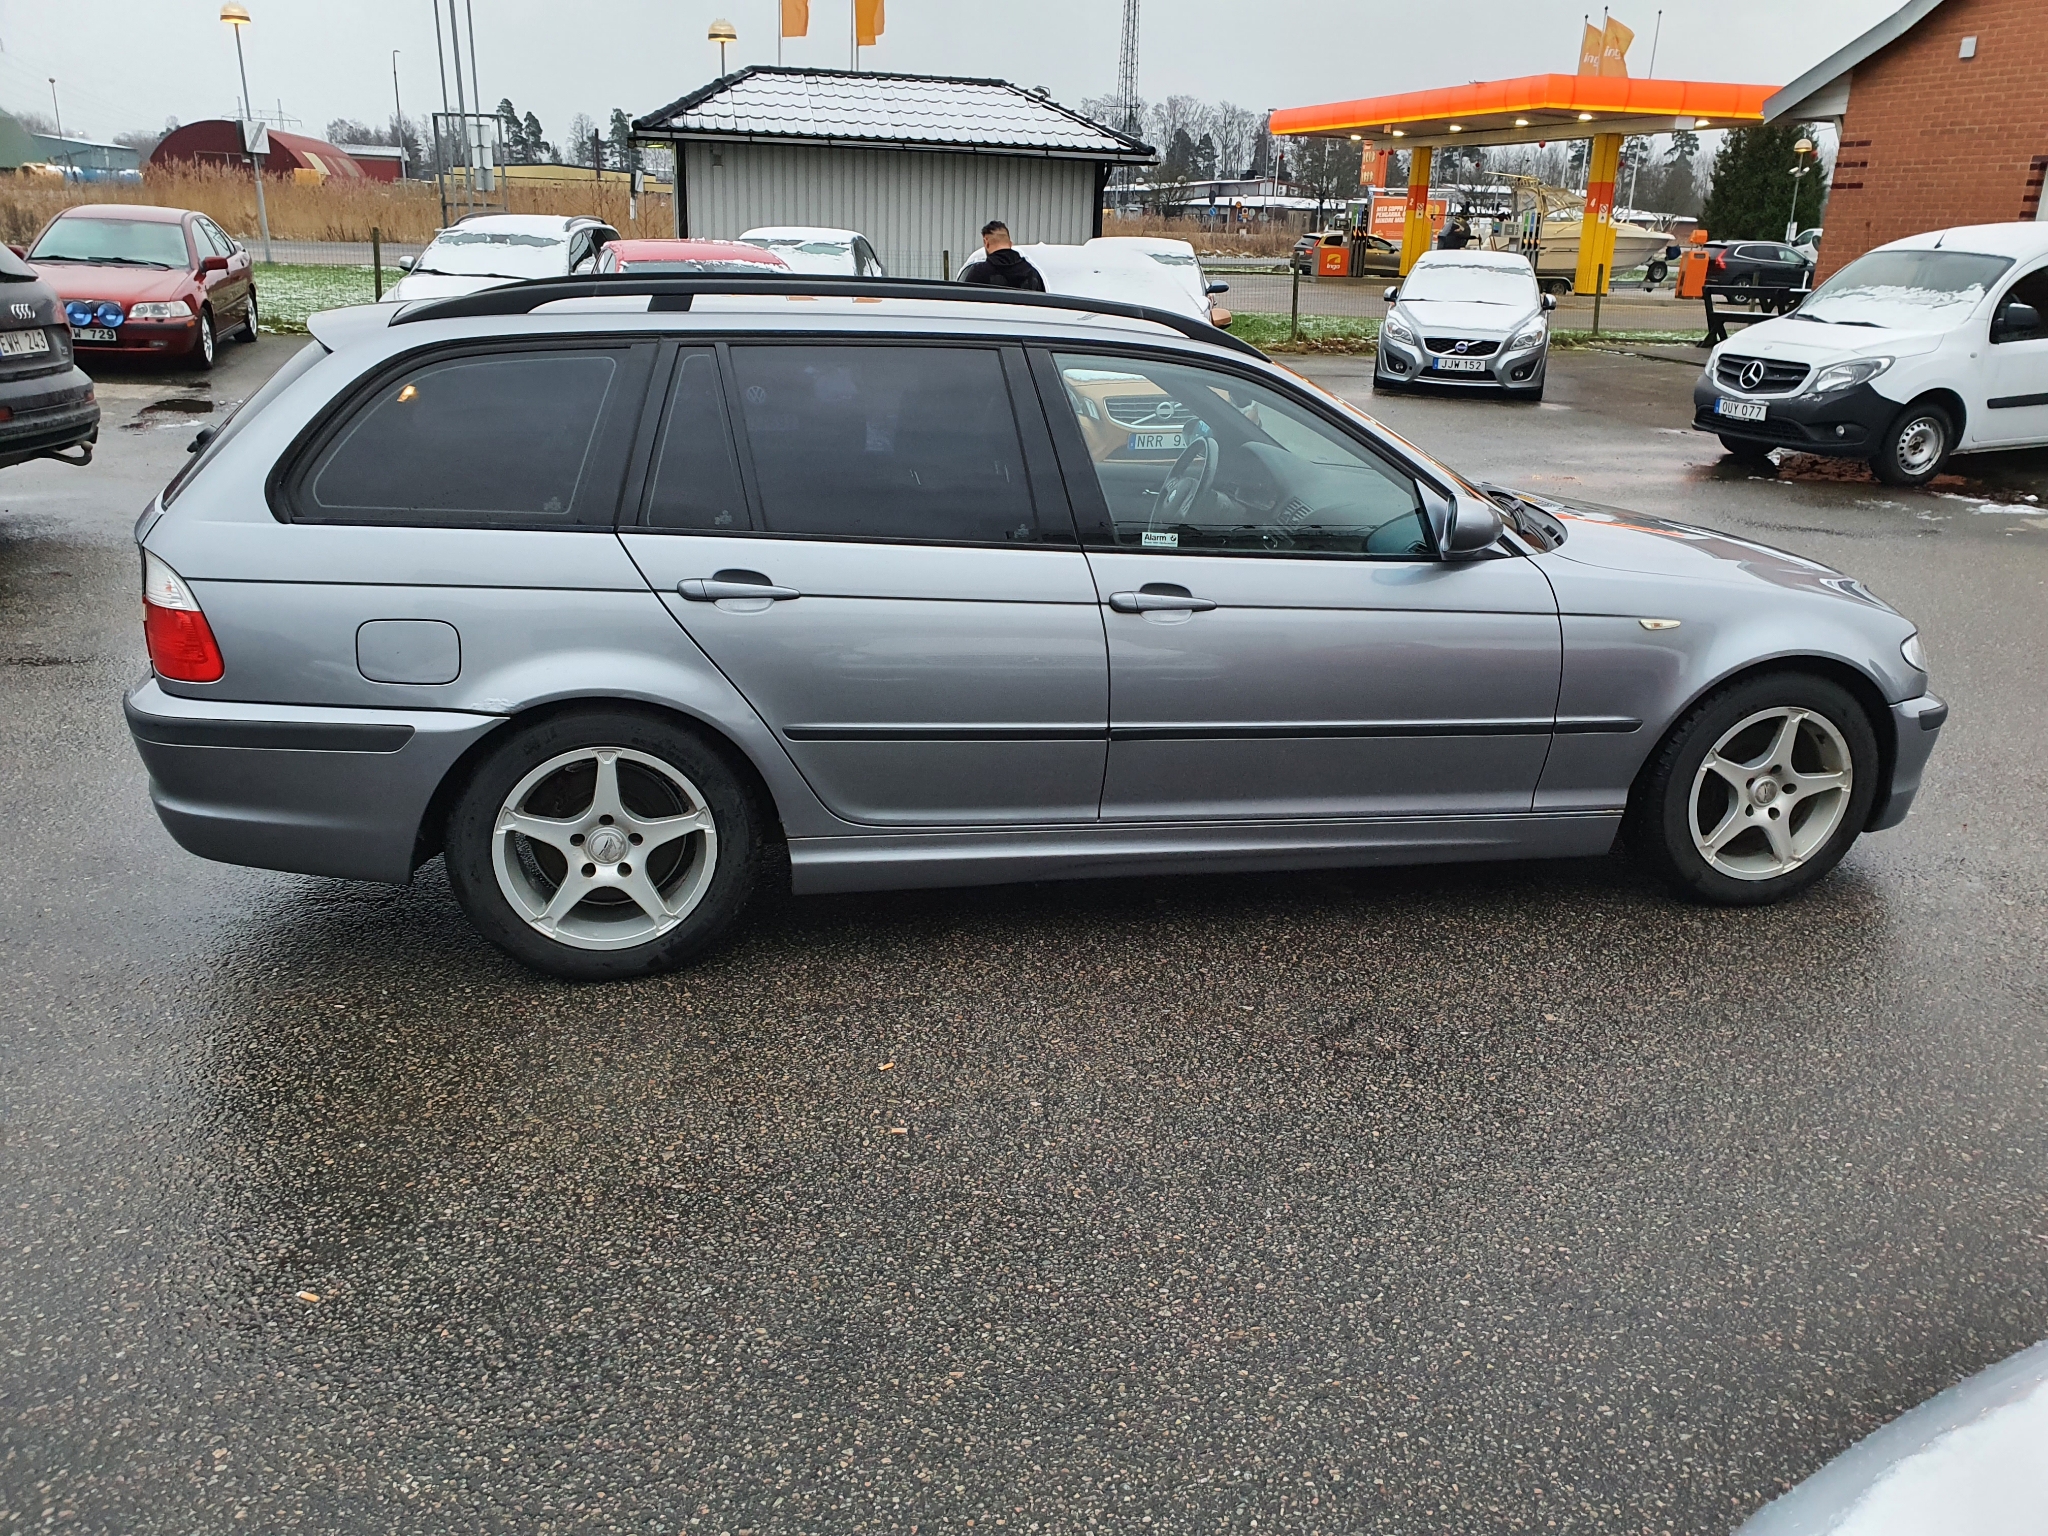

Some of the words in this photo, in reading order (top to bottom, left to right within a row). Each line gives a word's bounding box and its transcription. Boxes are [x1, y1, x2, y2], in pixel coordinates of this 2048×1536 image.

[1409, 198, 1414, 206] 2
[1590, 198, 1596, 207] 4
[90, 329, 114, 339] 729
[0, 334, 22, 354] EWH
[25, 331, 46, 350] 243
[1441, 360, 1461, 369] JJW
[1464, 361, 1482, 370] 152
[1722, 401, 1740, 415] OUY
[1741, 405, 1762, 418] 077
[1137, 435, 1164, 448] NRR
[1144, 533, 1167, 541] Alarm
